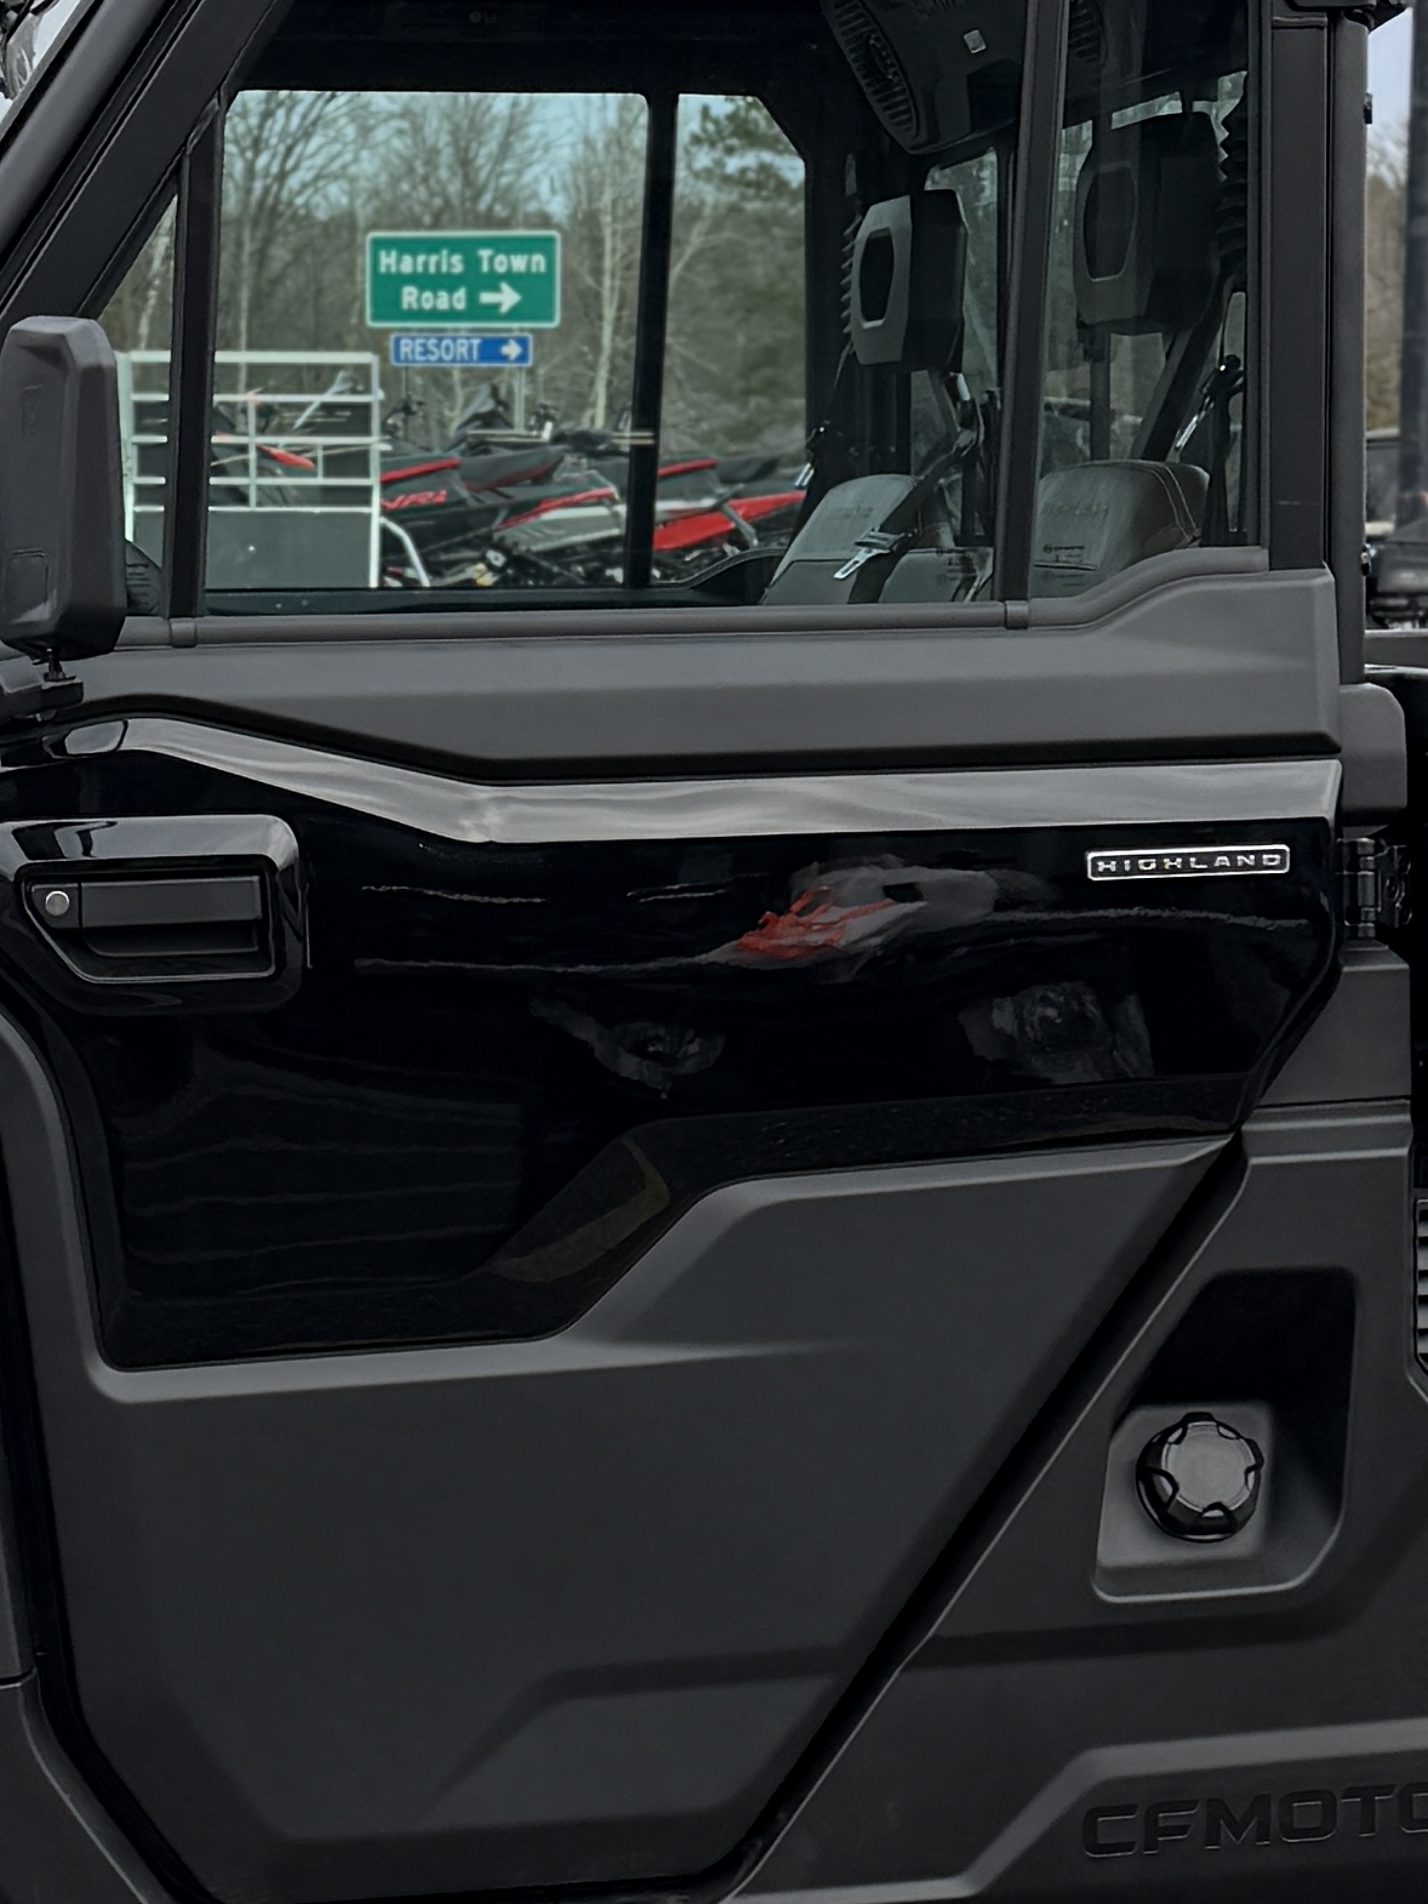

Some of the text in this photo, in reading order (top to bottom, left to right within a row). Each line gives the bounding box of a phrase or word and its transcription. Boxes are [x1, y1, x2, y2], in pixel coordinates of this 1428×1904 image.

[378, 248, 547, 274] Harris Town
[401, 285, 467, 311] Road
[398, 338, 482, 362] RESORT
[1097, 853, 1282, 873] HIGHLAND
